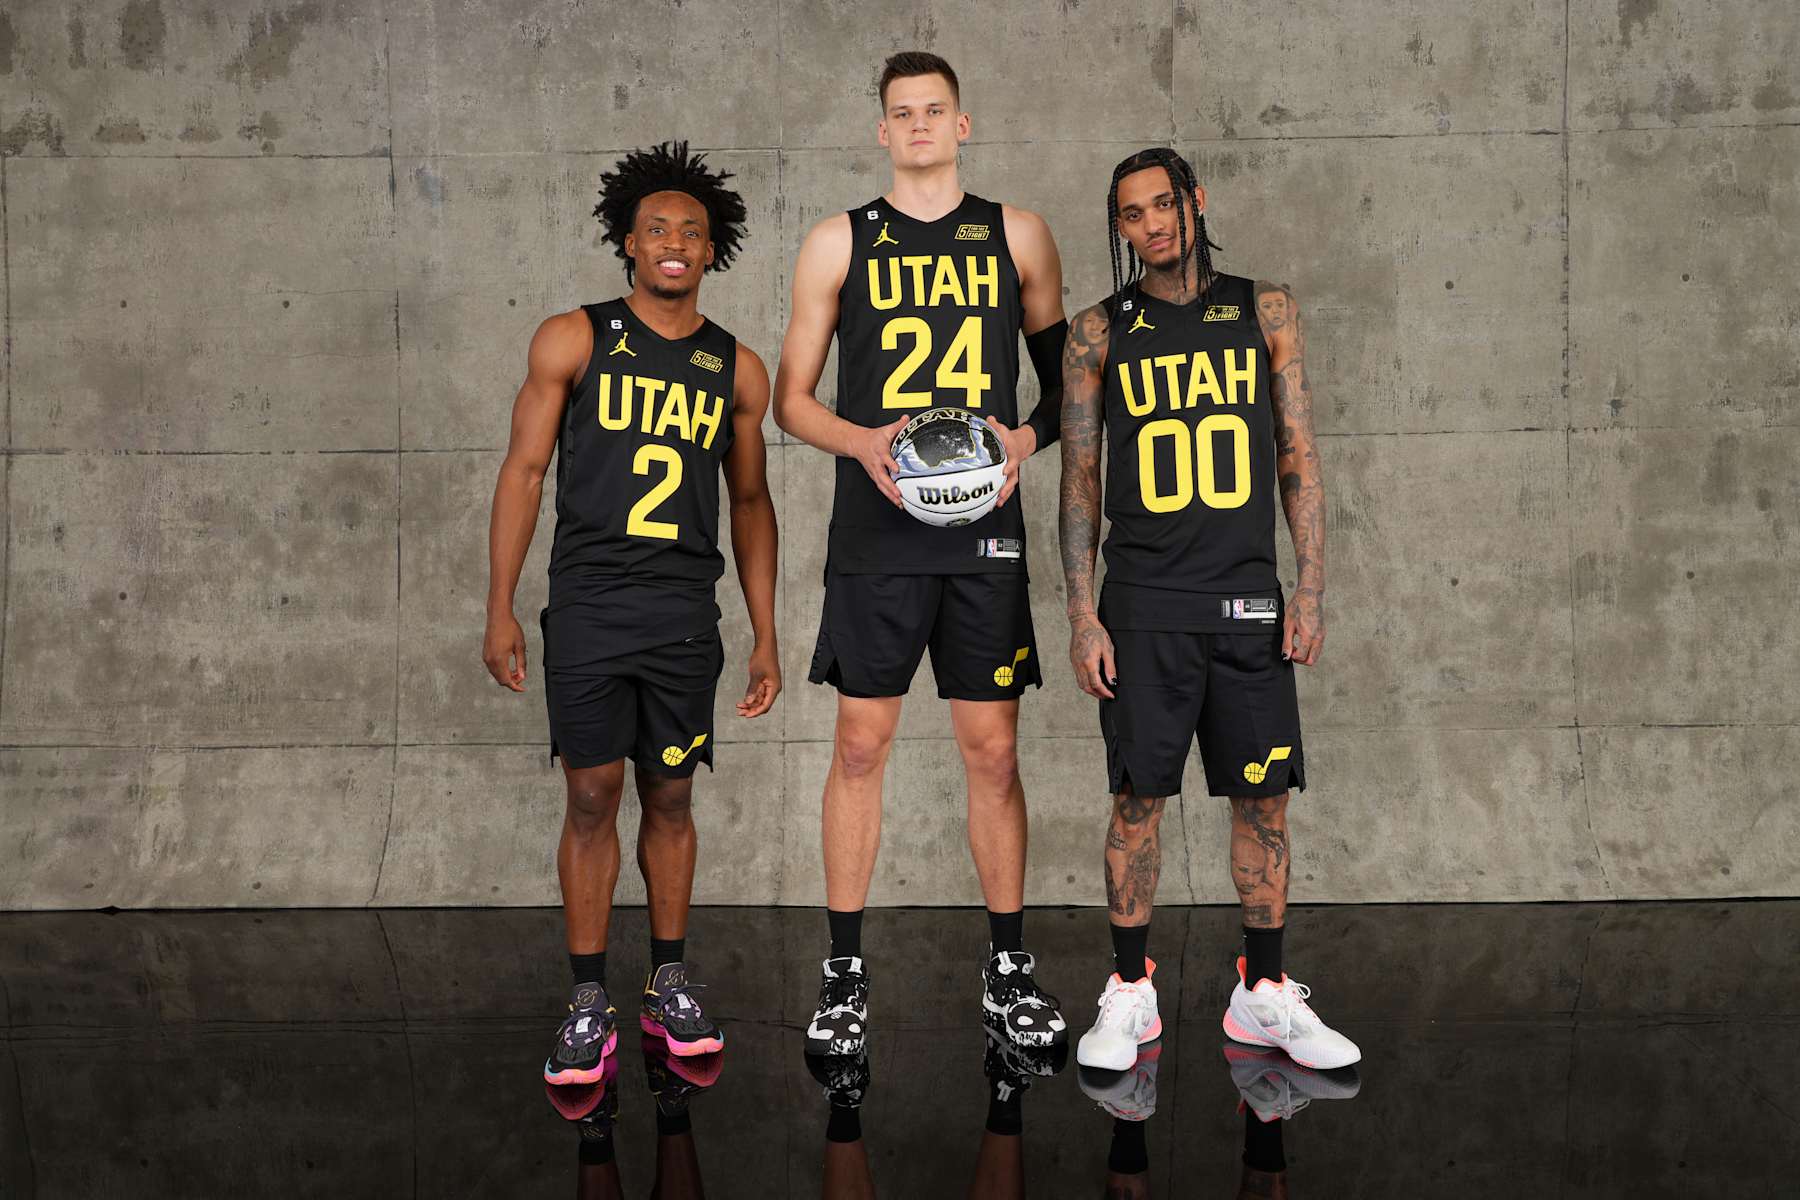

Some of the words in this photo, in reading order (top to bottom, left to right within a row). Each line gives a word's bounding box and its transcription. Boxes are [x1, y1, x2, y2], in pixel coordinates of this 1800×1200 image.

[866, 210, 879, 220] 6
[867, 255, 999, 310] UTAH
[1122, 300, 1133, 311] 6
[610, 319, 623, 330] 6
[881, 316, 991, 409] 24
[1118, 348, 1257, 417] UTAH
[598, 373, 725, 450] UTAH
[626, 443, 683, 540] 2
[916, 481, 994, 505] Wilson
[1137, 414, 1252, 514] 00
